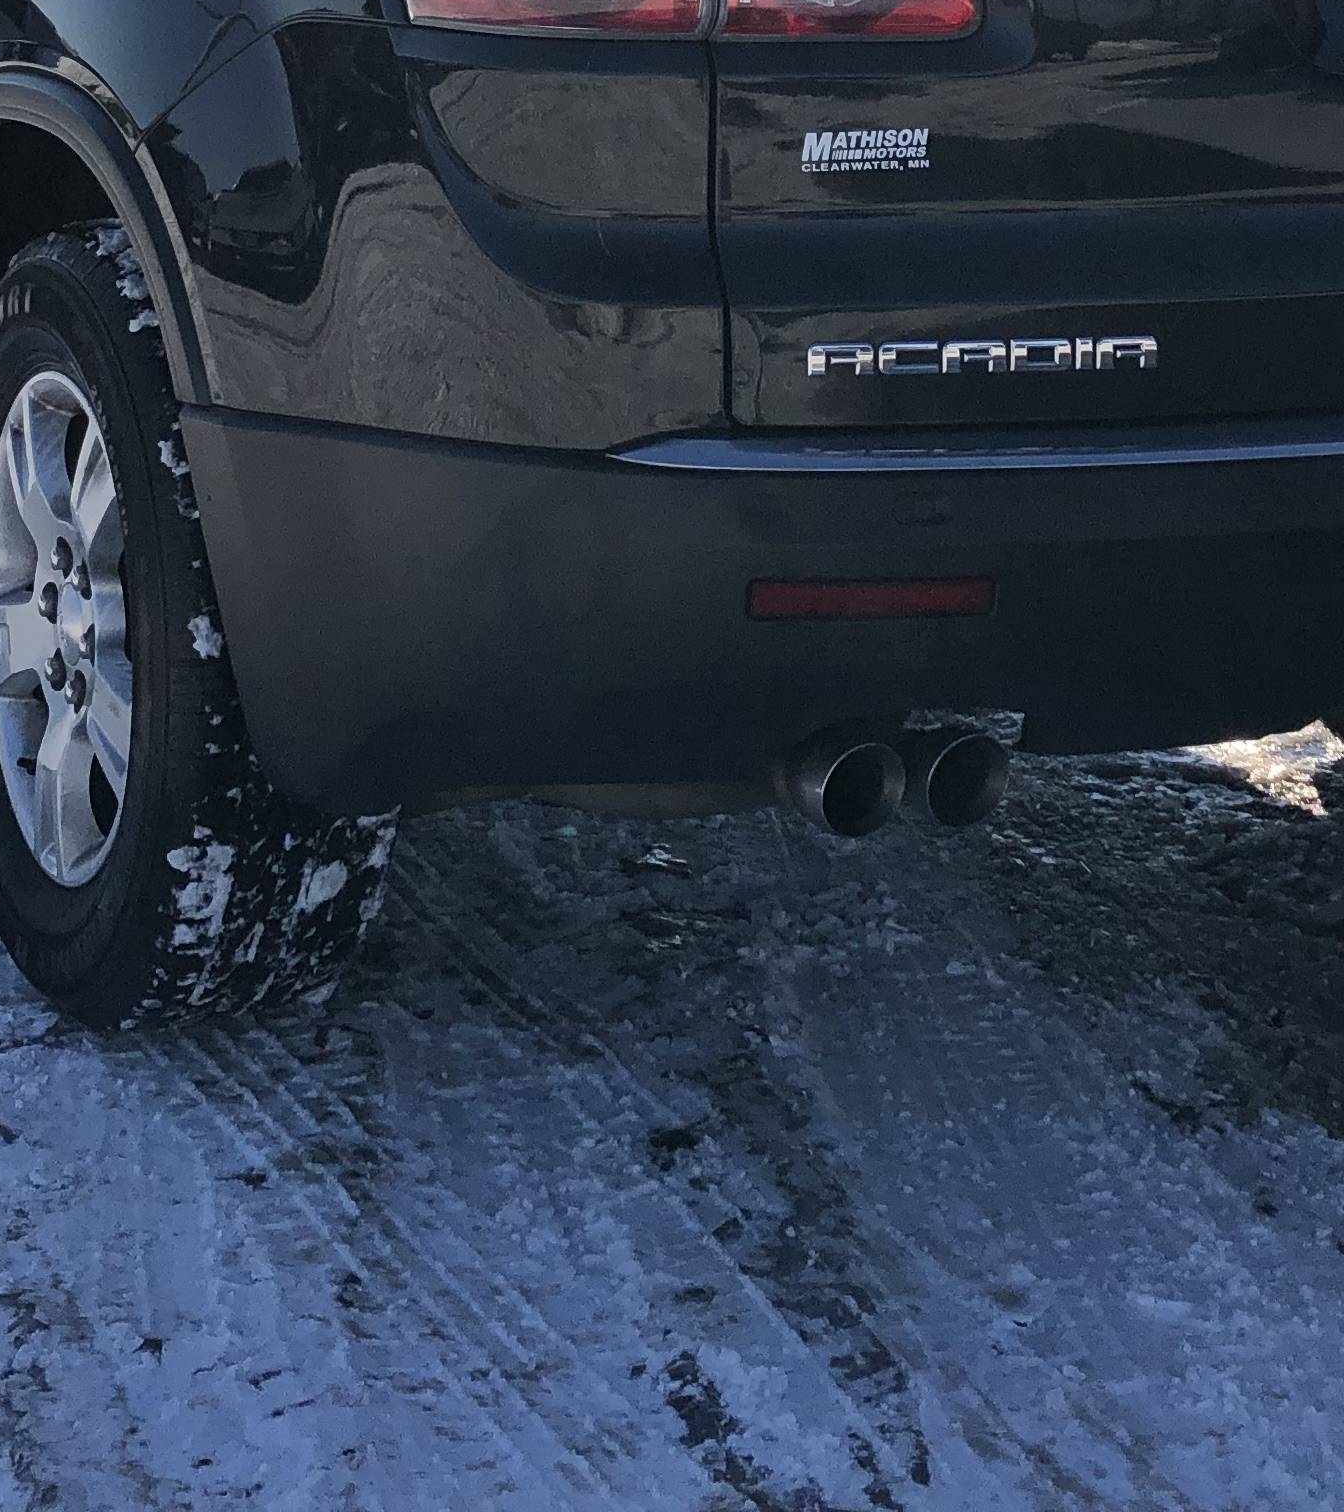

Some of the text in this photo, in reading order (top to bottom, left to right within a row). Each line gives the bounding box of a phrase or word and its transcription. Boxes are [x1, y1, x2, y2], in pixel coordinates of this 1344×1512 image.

[801, 128, 929, 162] MATHISON
[863, 146, 927, 160] MOTORS
[801, 159, 930, 172] CLEARWATER, MN
[807, 336, 1157, 377] ACADIA
